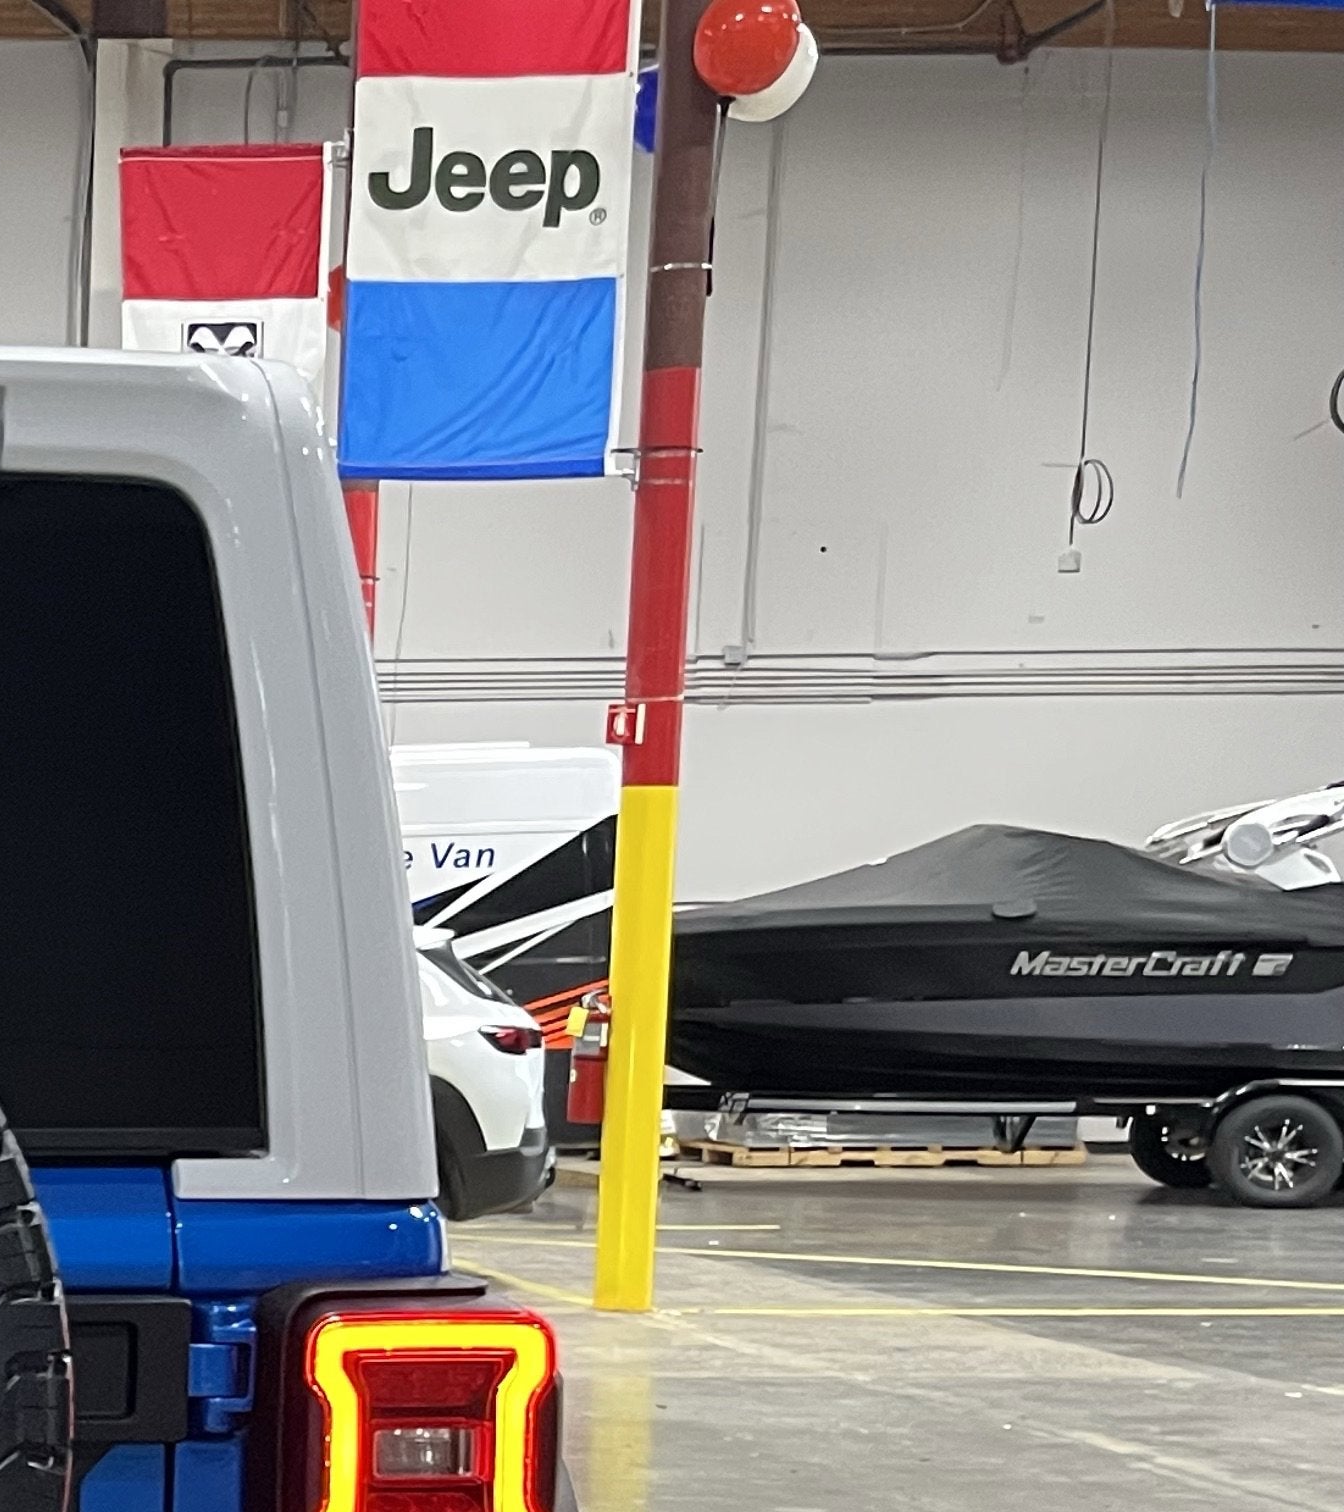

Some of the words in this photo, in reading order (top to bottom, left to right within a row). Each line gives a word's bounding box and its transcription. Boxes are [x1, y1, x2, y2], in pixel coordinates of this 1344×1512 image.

[368, 127, 600, 228] Jeep
[430, 842, 496, 869] Van
[1010, 951, 1247, 977] MasterCraft
